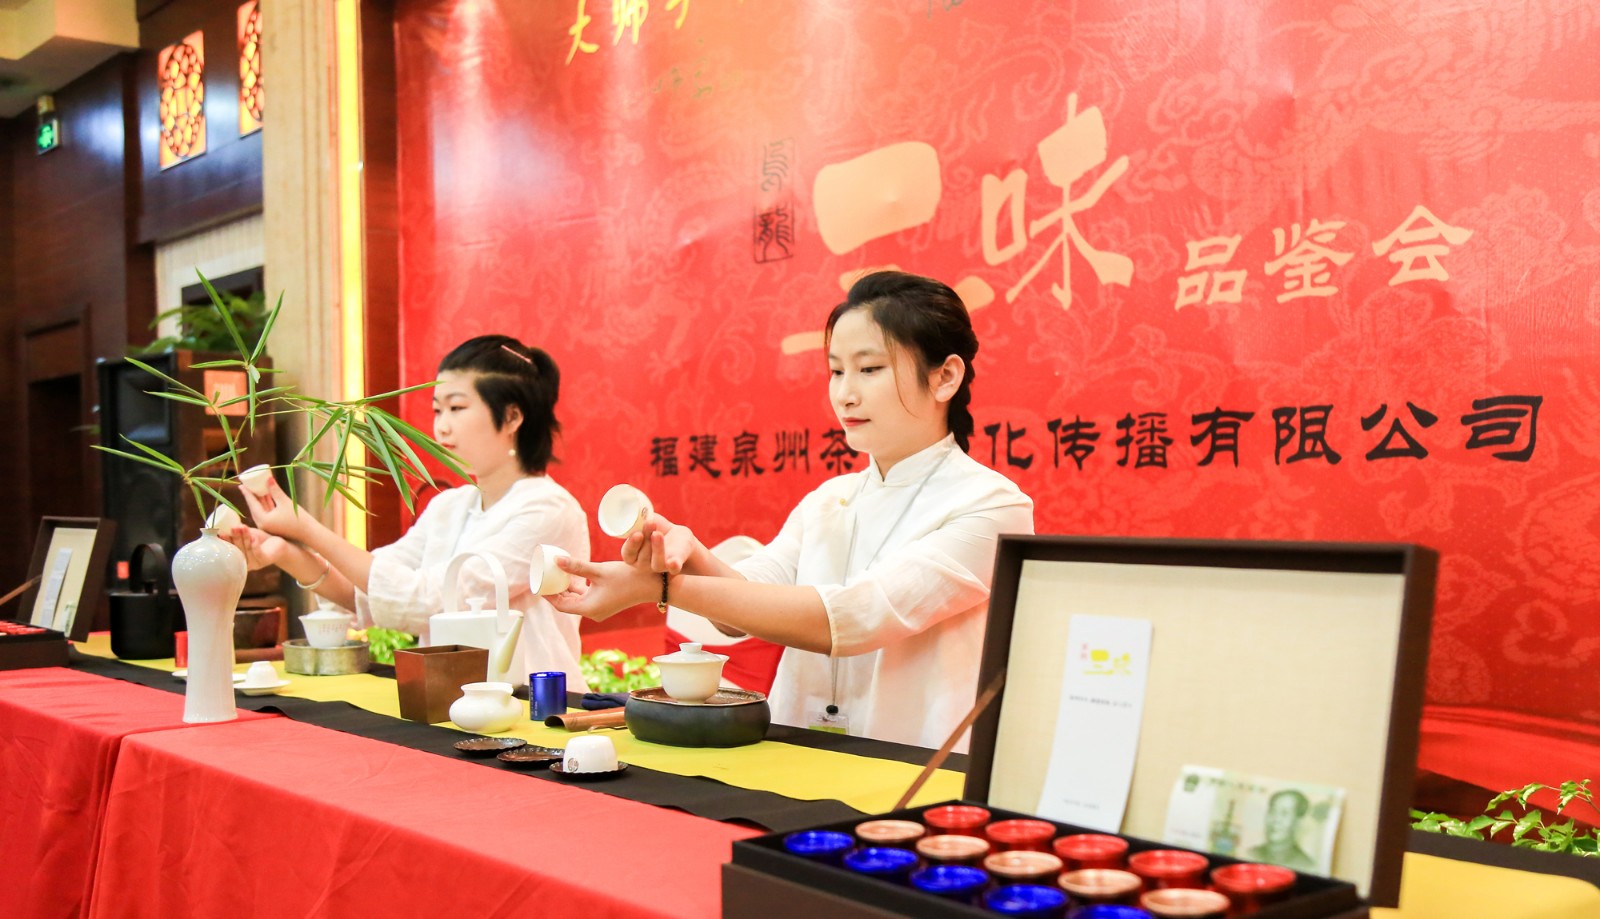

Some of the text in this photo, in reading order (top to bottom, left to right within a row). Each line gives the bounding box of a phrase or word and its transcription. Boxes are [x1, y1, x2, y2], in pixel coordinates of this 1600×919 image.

[565, 0, 690, 66] 大师
[1174, 205, 1474, 312] 品鉴会
[650, 395, 1544, 478] 福建泉州茶化传播有限公司
